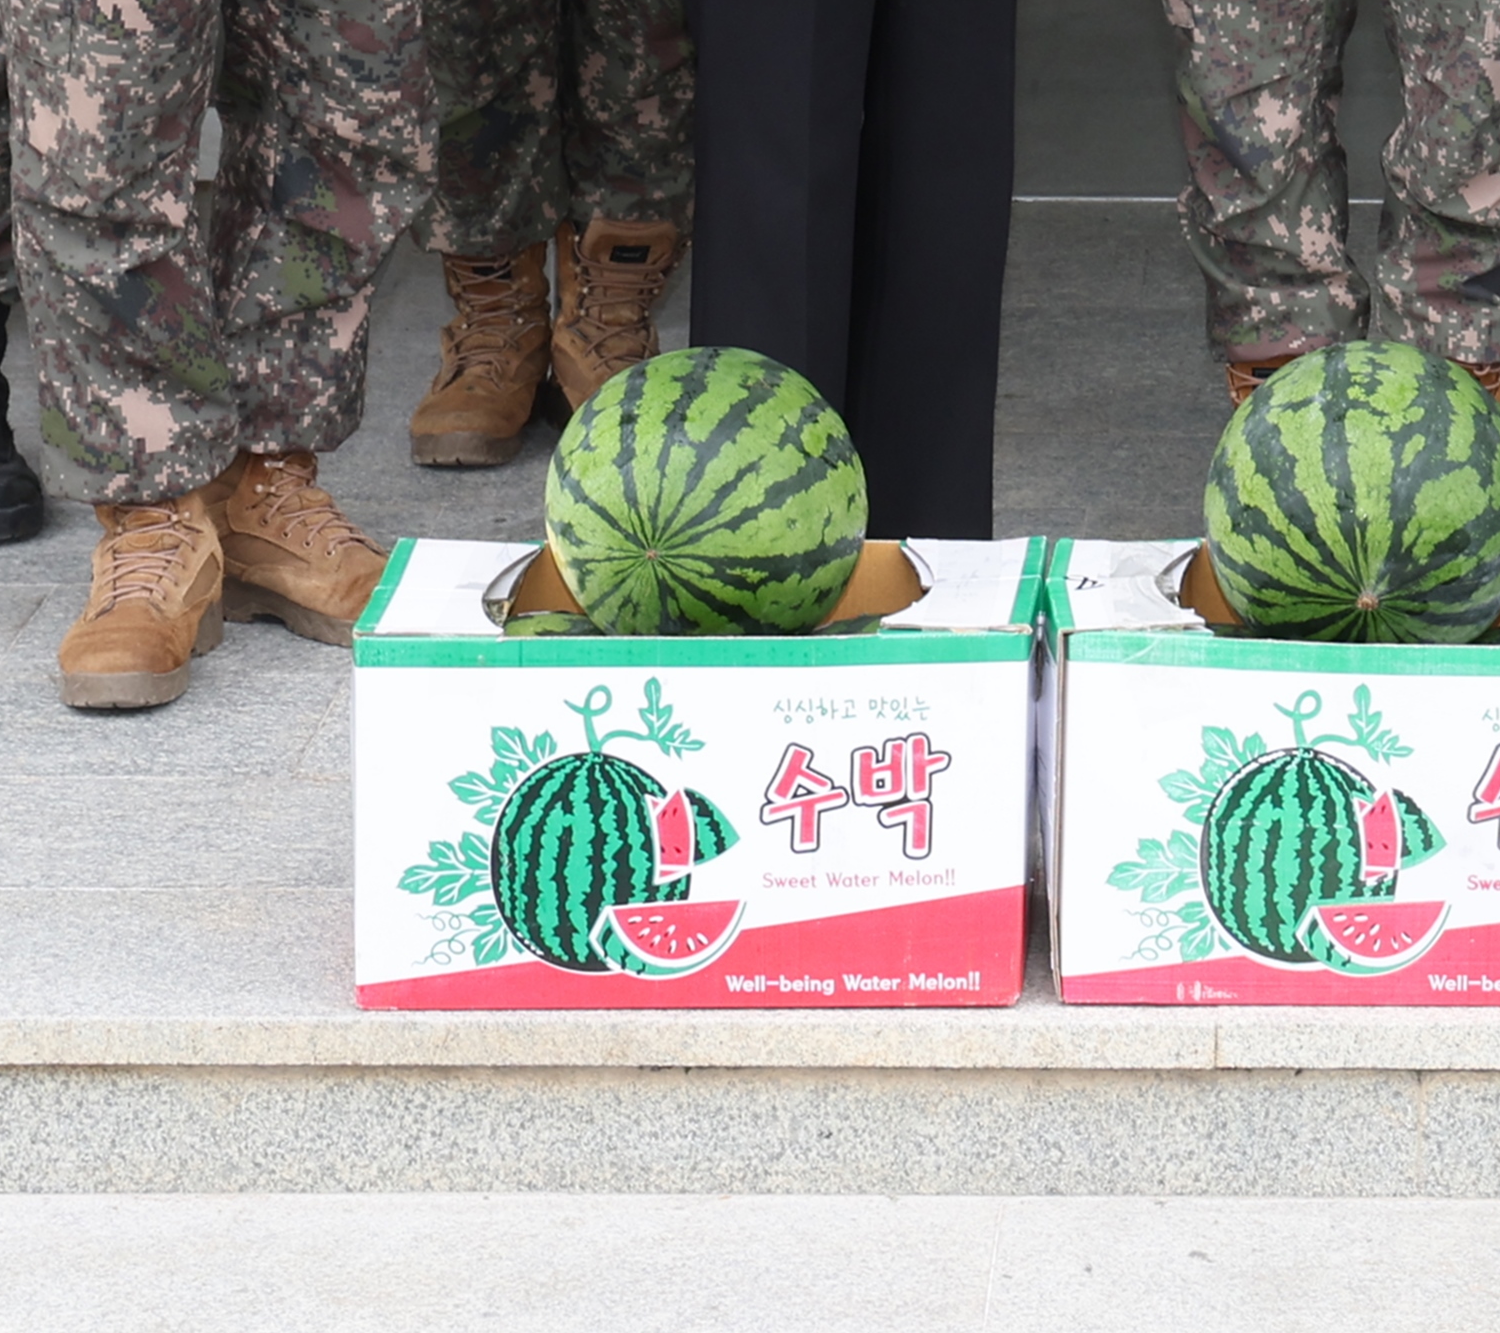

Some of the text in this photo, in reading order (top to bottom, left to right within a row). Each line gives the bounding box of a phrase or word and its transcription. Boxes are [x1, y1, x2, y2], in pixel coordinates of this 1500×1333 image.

[772, 695, 932, 726] 싱싱하고 맛있는
[760, 731, 952, 860] 수박
[762, 867, 957, 890] Sweet Water Melon!!
[725, 971, 981, 995] Well-being Water Melon!!
